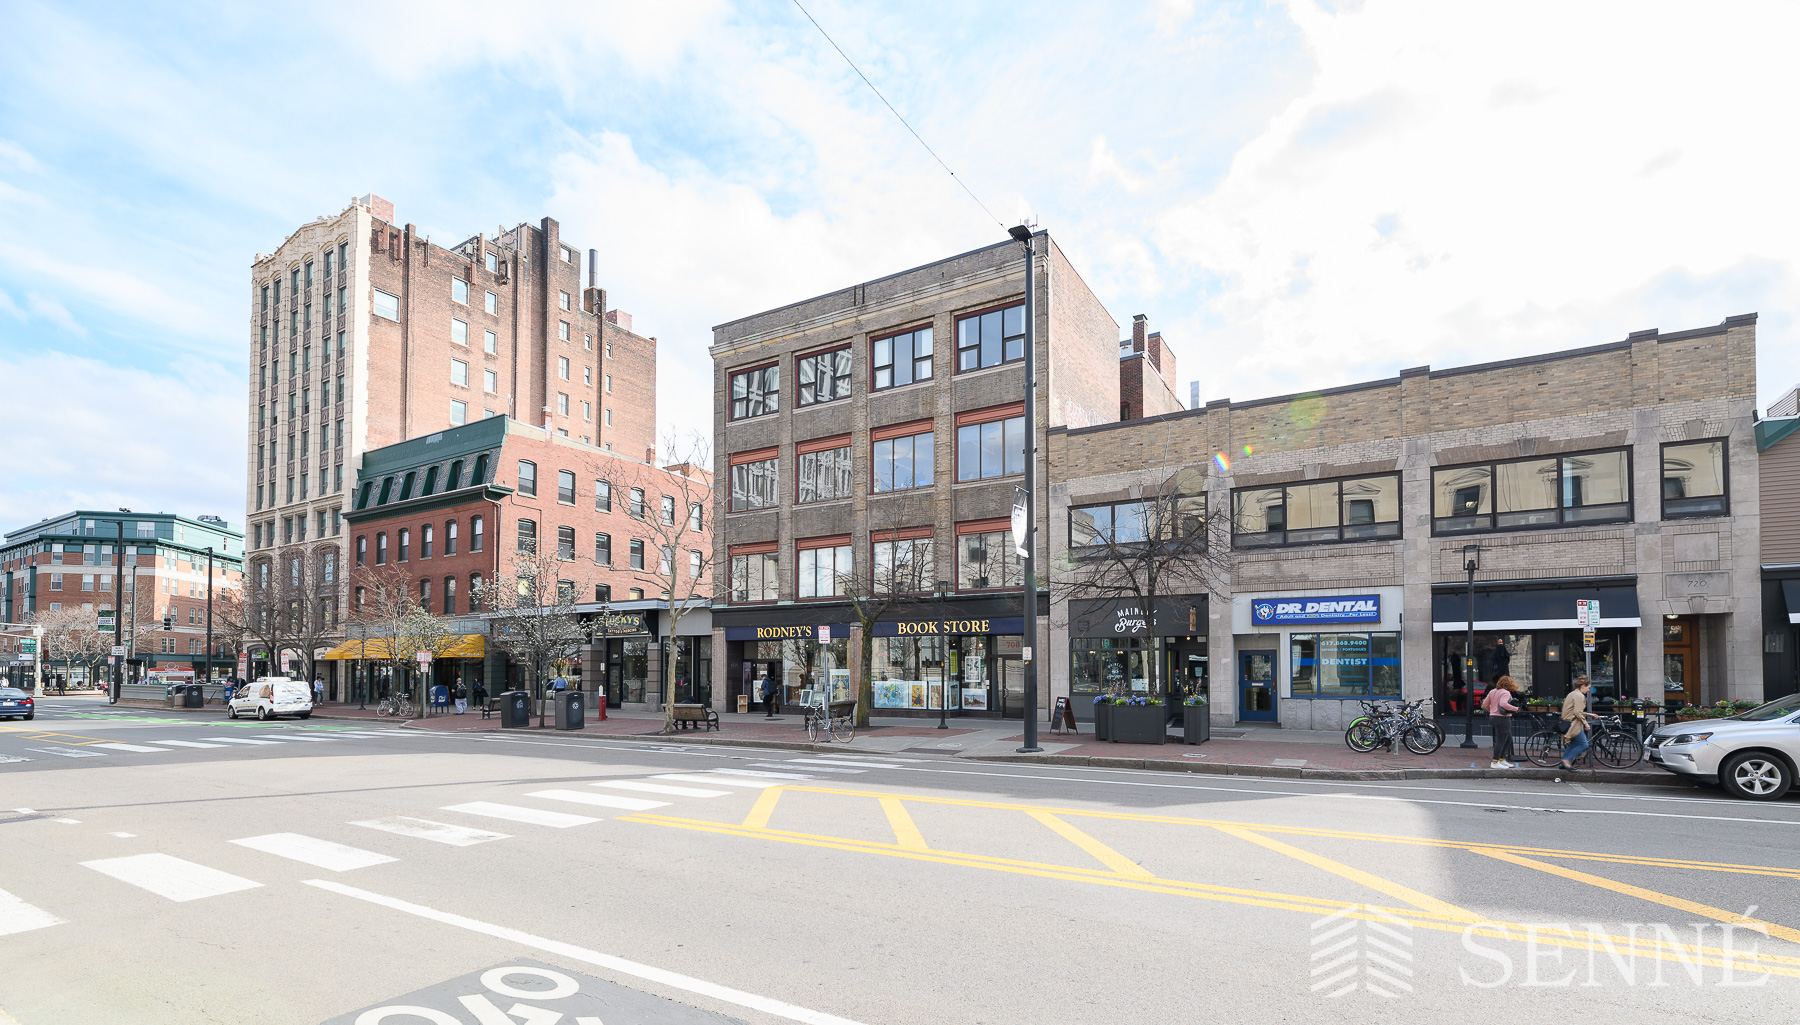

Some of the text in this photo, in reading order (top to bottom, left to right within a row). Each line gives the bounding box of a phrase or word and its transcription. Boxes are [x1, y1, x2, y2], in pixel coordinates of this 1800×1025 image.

[1275, 600, 1377, 614] DR. DENTAL
[605, 614, 640, 626] LUCKY'S
[757, 625, 812, 638] RODNEY'S
[897, 619, 990, 635] BOOK STORE
[1006, 641, 1020, 649] 700
